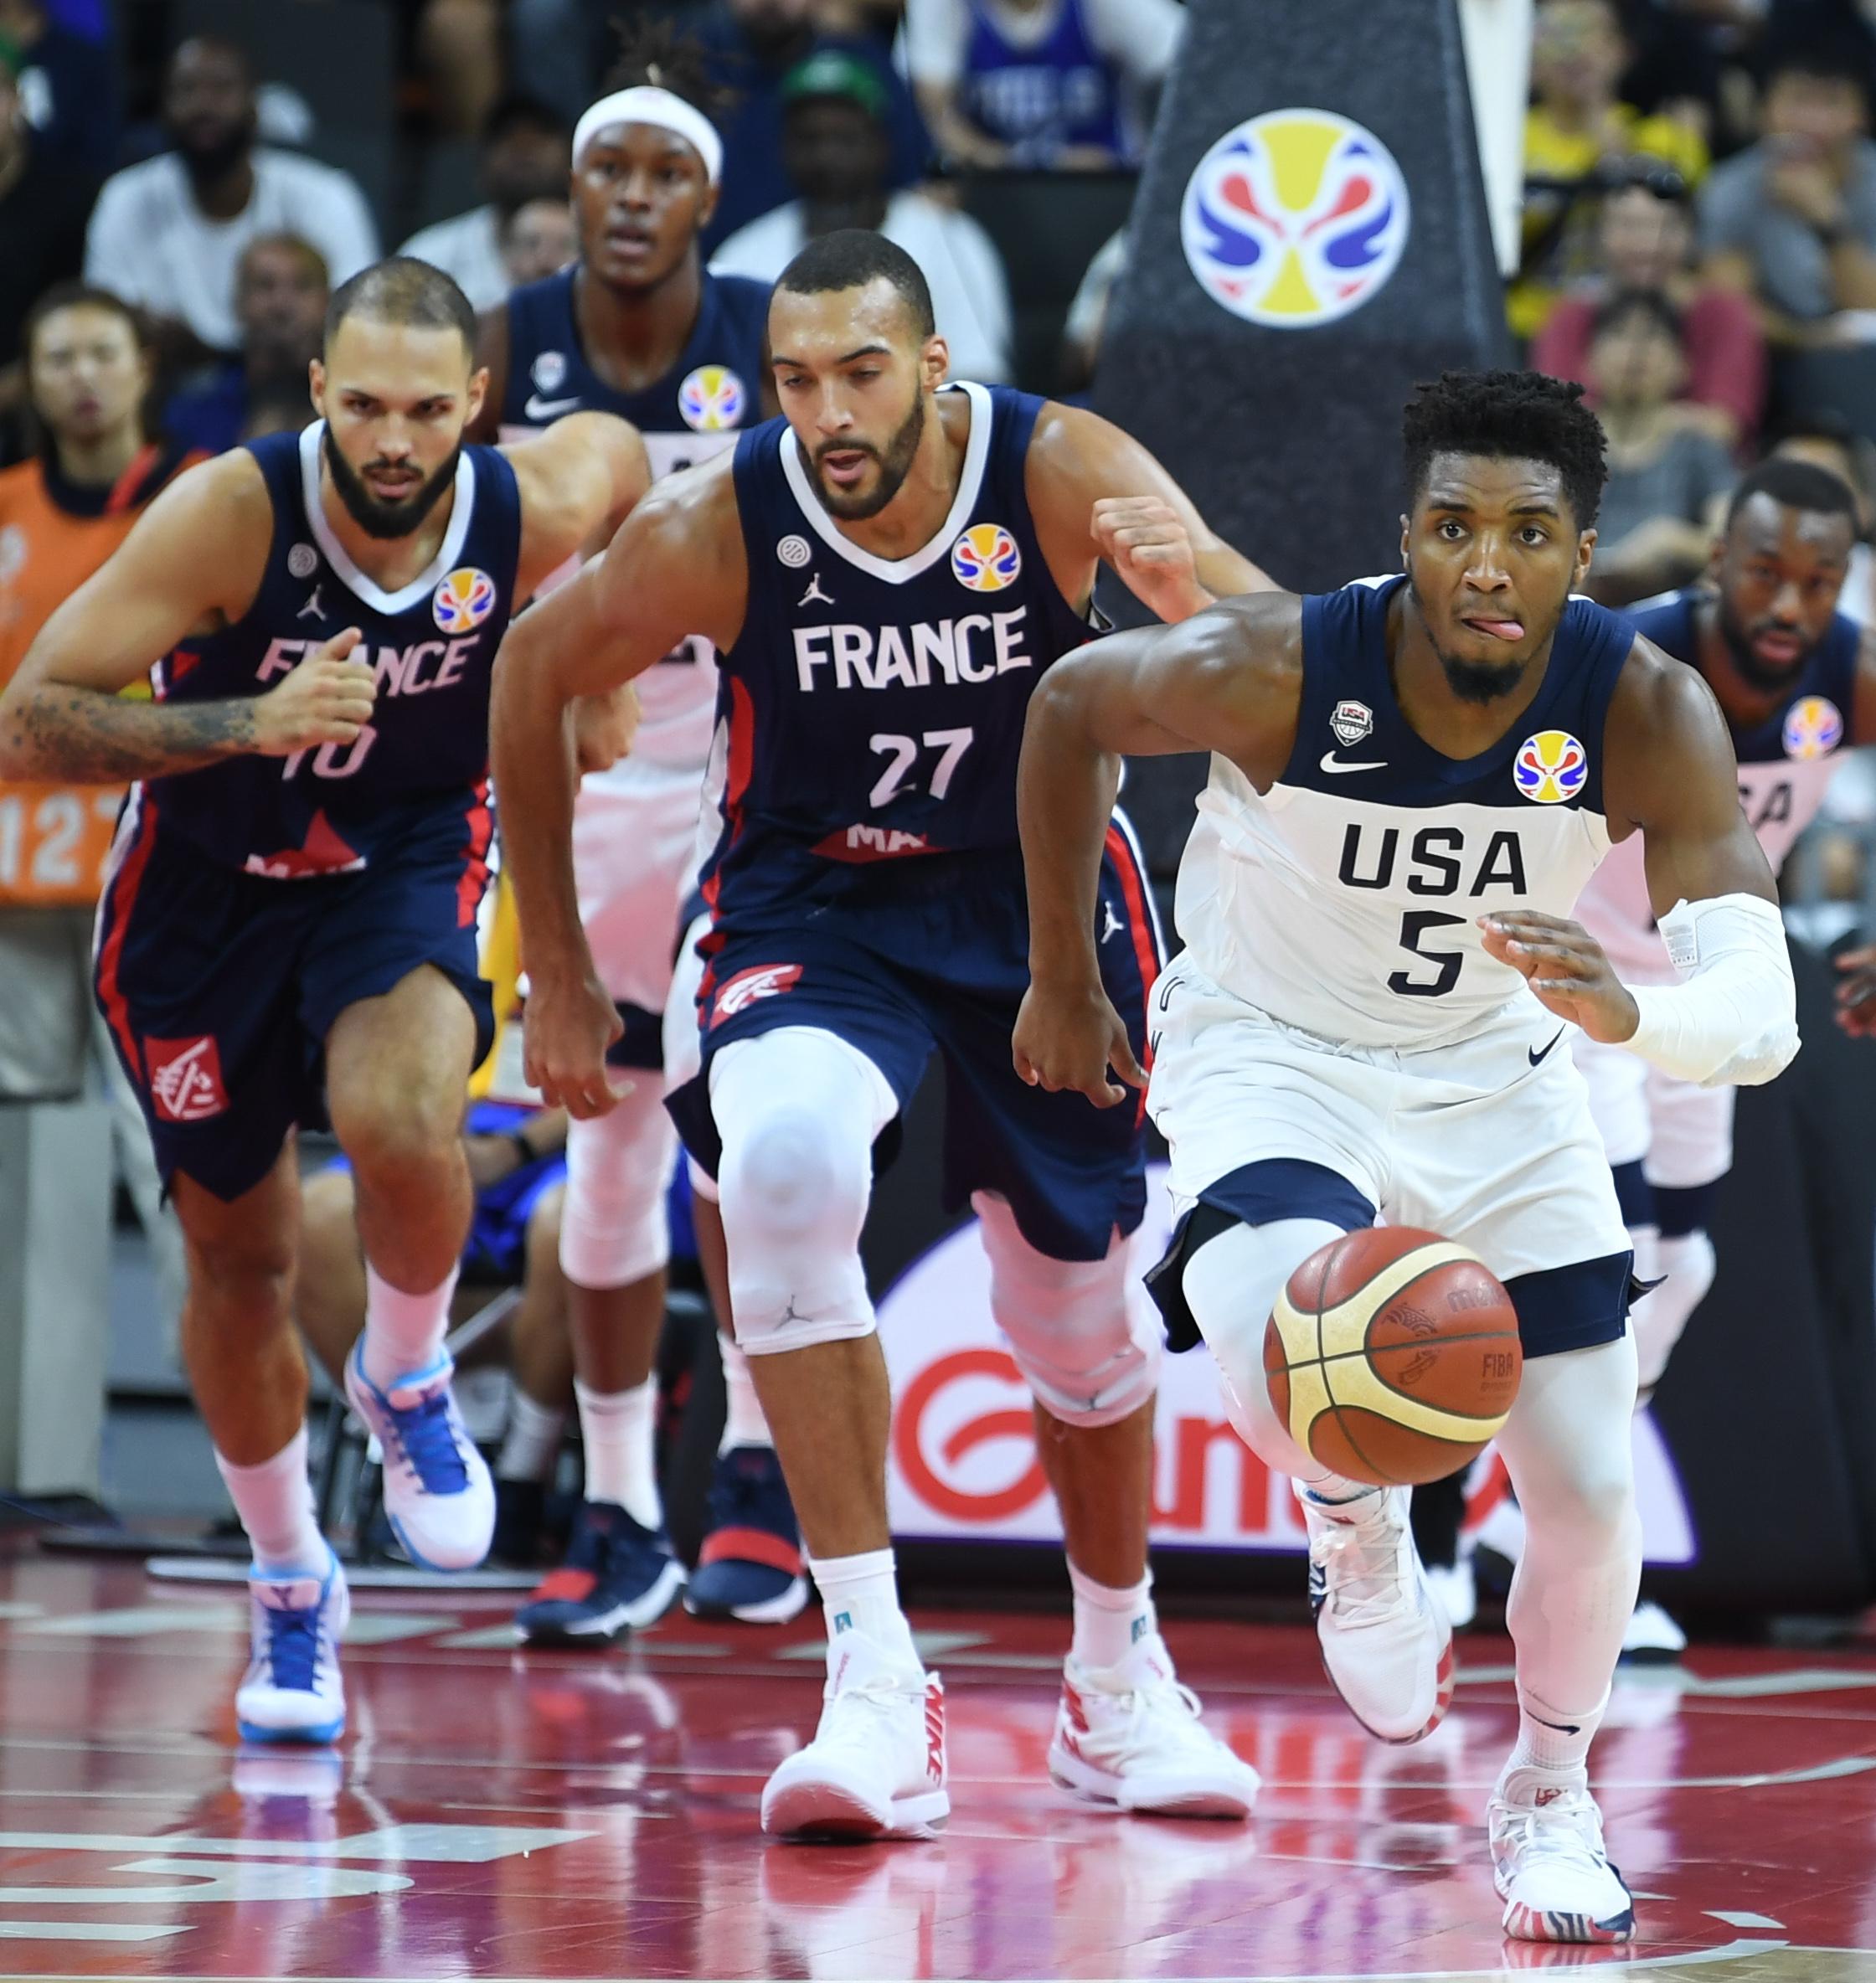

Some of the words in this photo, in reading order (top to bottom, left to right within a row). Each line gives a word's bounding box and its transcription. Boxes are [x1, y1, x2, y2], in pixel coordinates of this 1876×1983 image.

[255, 634, 480, 698] FNCE
[792, 605, 1032, 692] FRANCE
[868, 727, 973, 808] 27
[1338, 824, 1527, 897] USA
[1387, 909, 1467, 997] 5
[1482, 1352, 1513, 1378] FIBA
